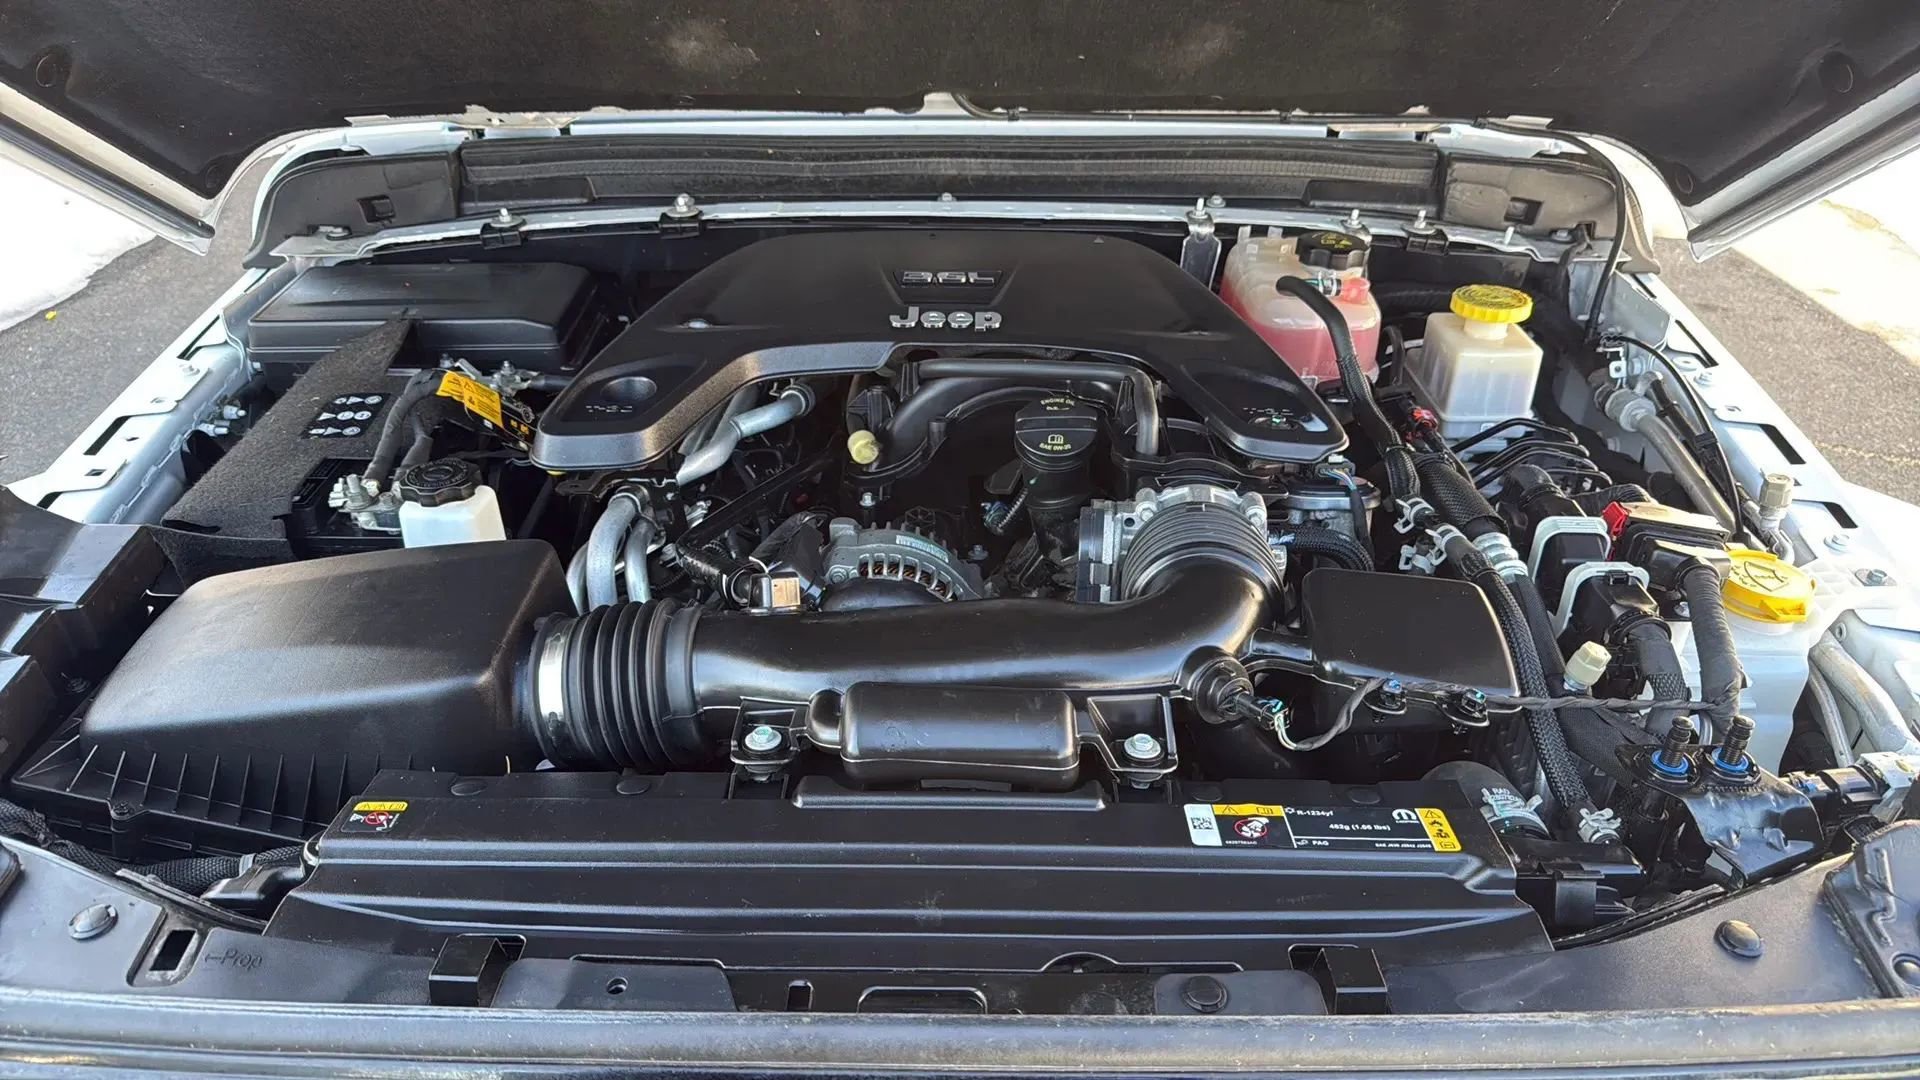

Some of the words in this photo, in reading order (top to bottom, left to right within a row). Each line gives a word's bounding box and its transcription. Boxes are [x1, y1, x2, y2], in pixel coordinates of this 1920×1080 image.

[889, 306, 1002, 331] Jeep
[1040, 398, 1065, 406] ENGINE
[1296, 809, 1334, 818] R-1234yf
